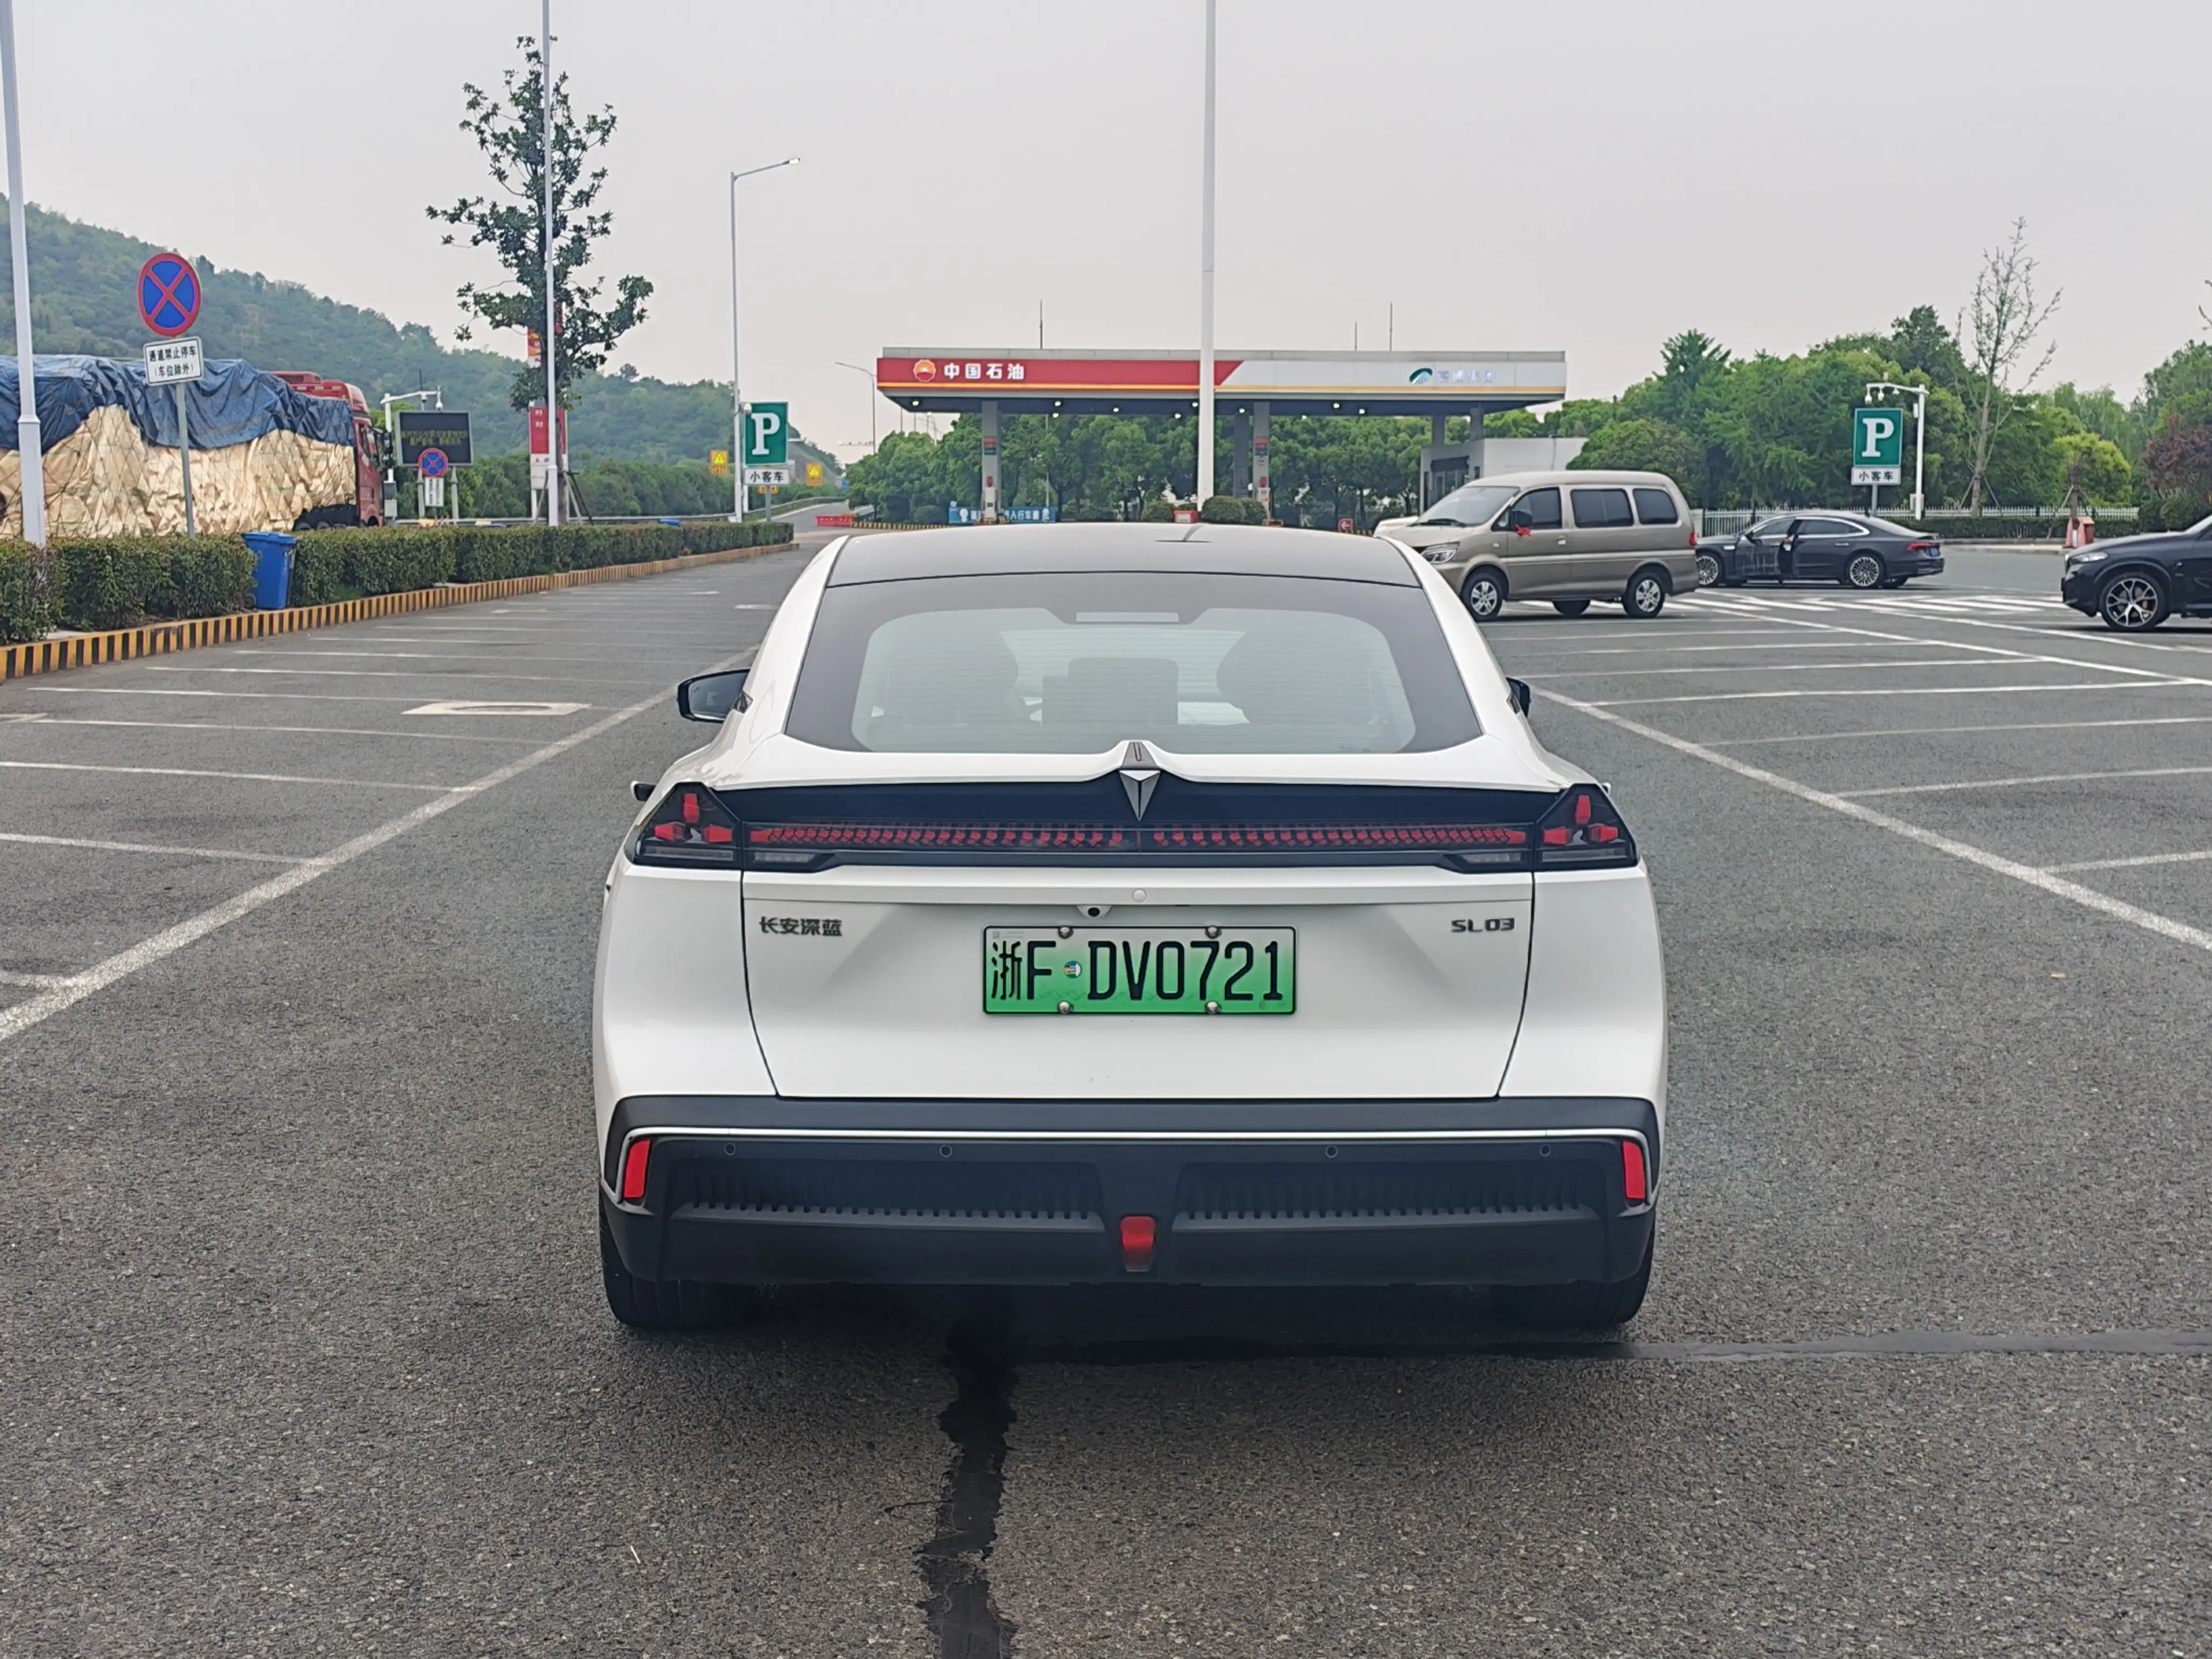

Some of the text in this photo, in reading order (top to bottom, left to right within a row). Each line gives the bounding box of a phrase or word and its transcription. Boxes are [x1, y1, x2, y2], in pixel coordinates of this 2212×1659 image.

[943, 362, 1024, 380] 中国石油
[751, 412, 780, 455] P
[1862, 417, 1894, 457] P
[750, 471, 784, 482] 小客车
[1859, 470, 1894, 482] 小客车
[759, 916, 842, 936] 长安深蓝
[1451, 918, 1515, 933] SL03
[1087, 940, 1284, 1001] DV0721
